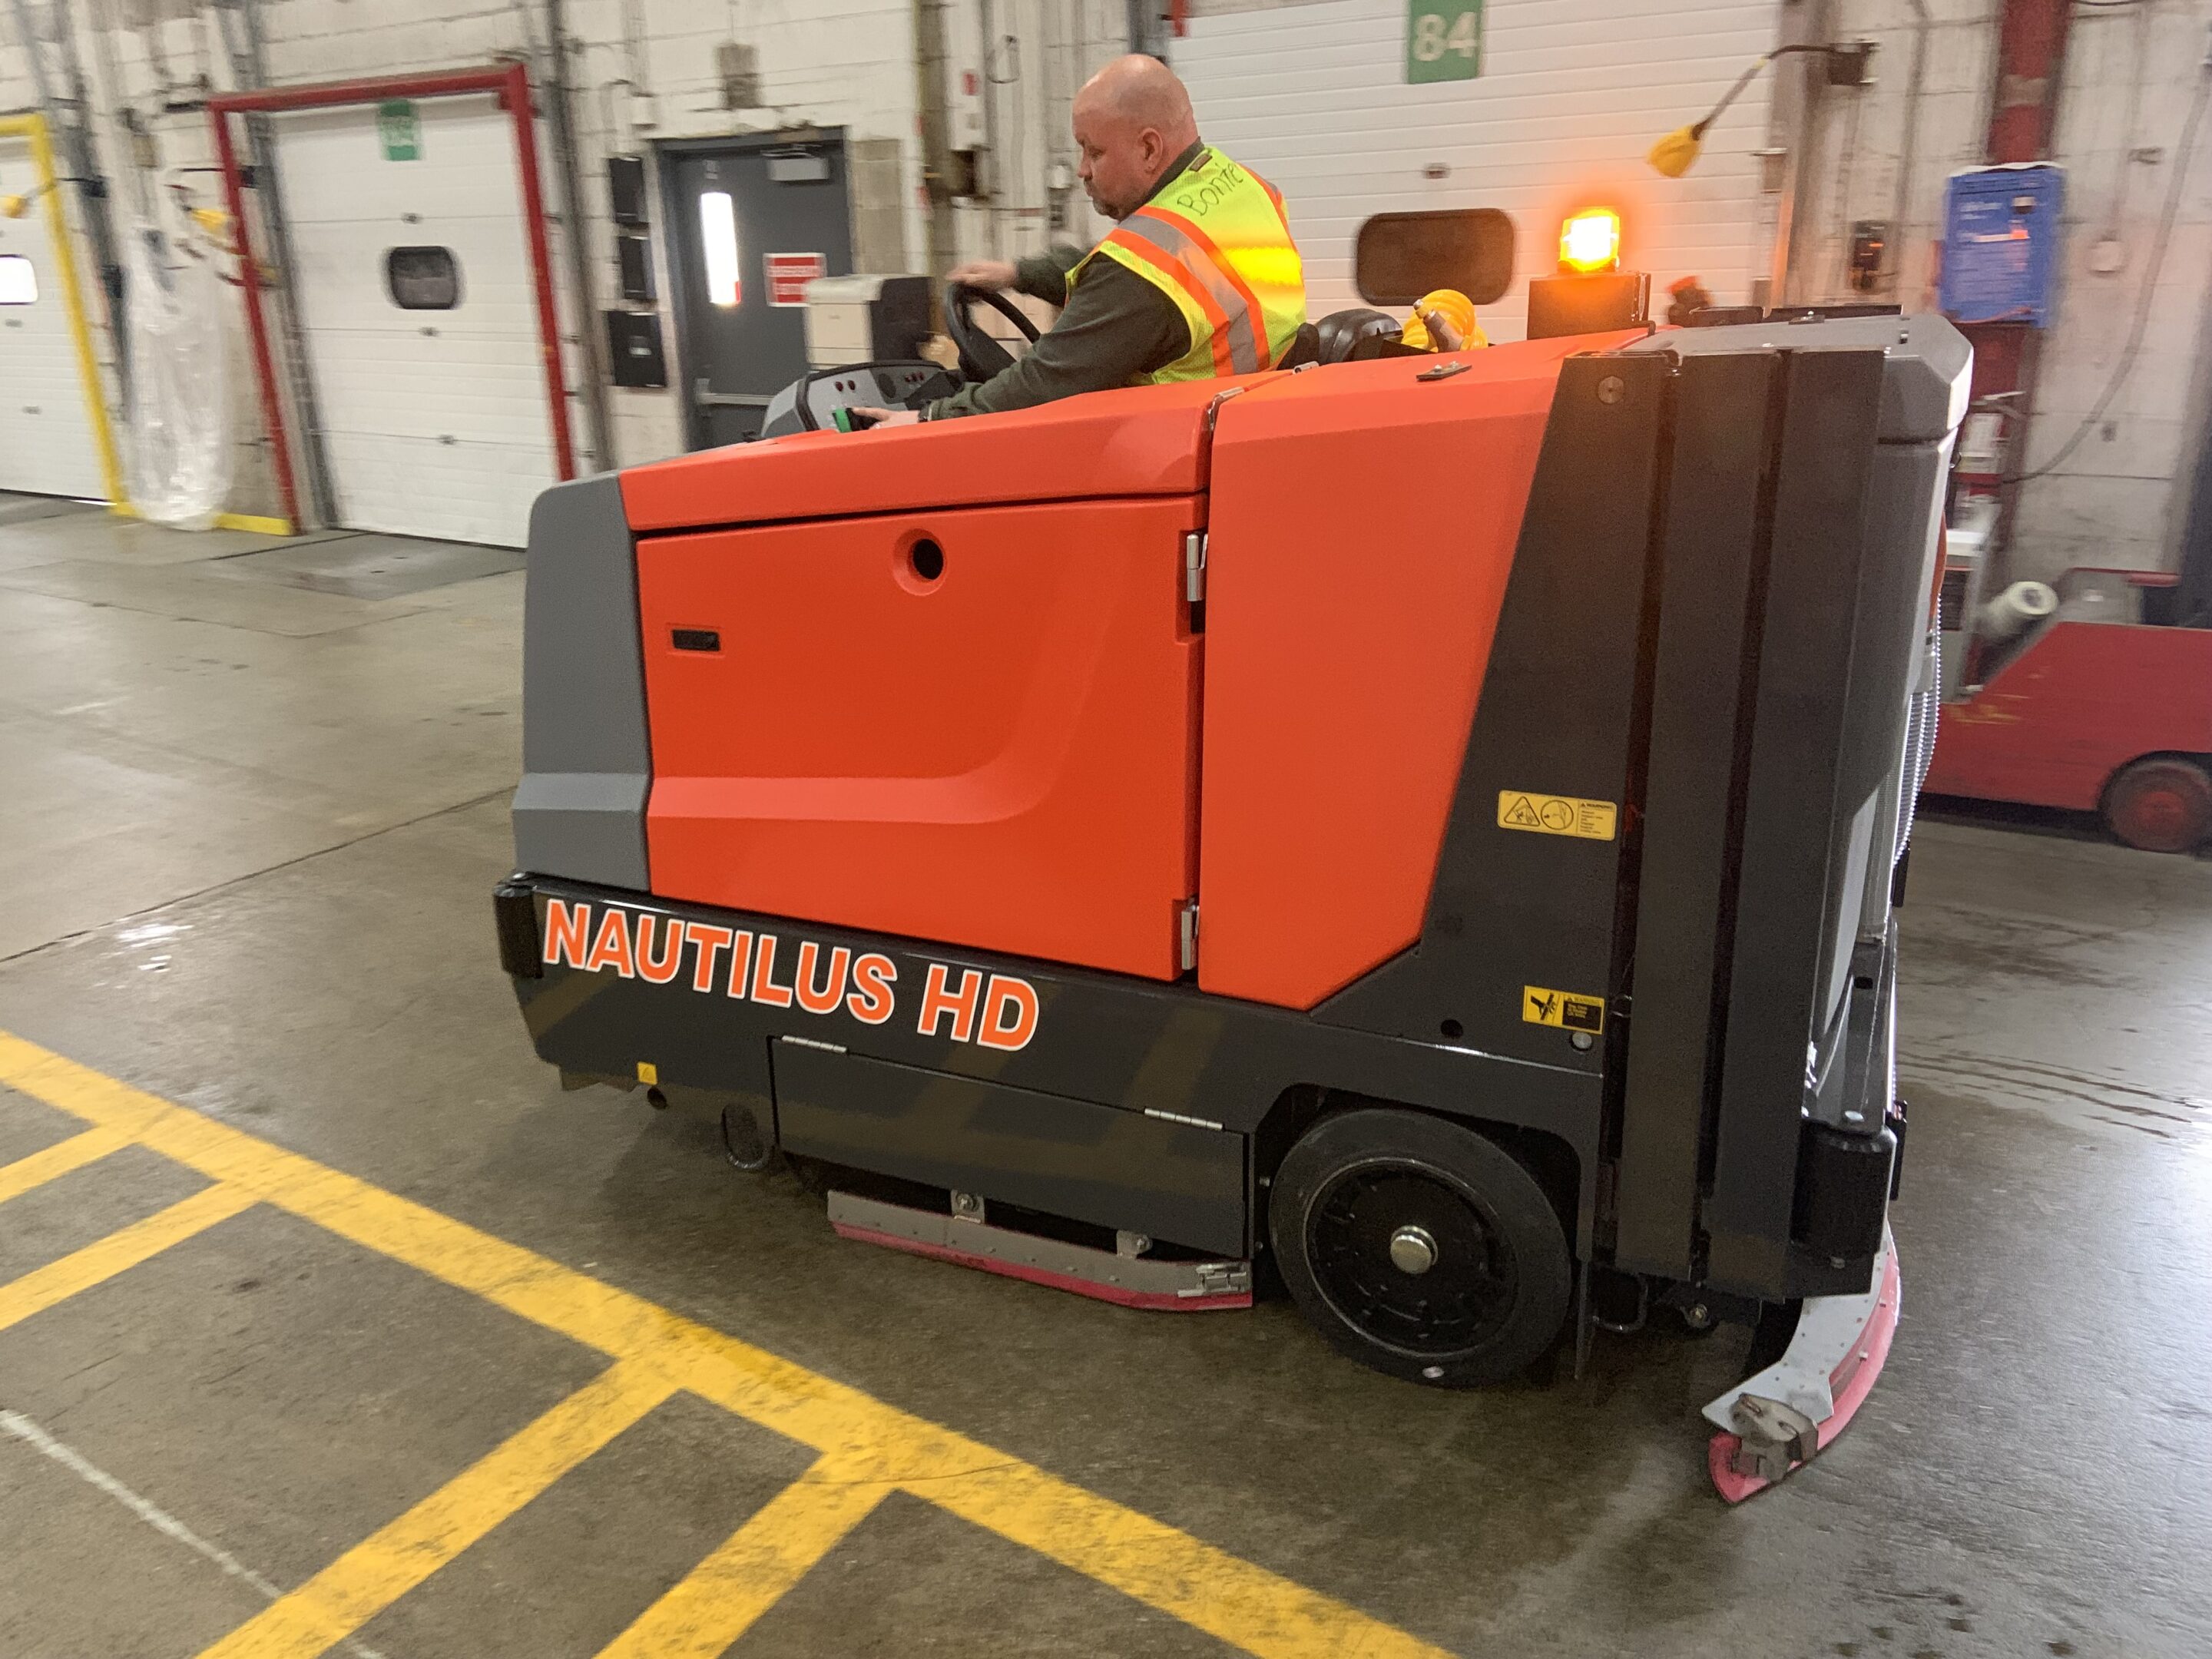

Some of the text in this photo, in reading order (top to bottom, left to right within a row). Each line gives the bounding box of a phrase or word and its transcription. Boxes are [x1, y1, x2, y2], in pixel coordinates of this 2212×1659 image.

[1414, 12, 1478, 61] 84
[543, 899, 1039, 1051] NAUTILUS HD
